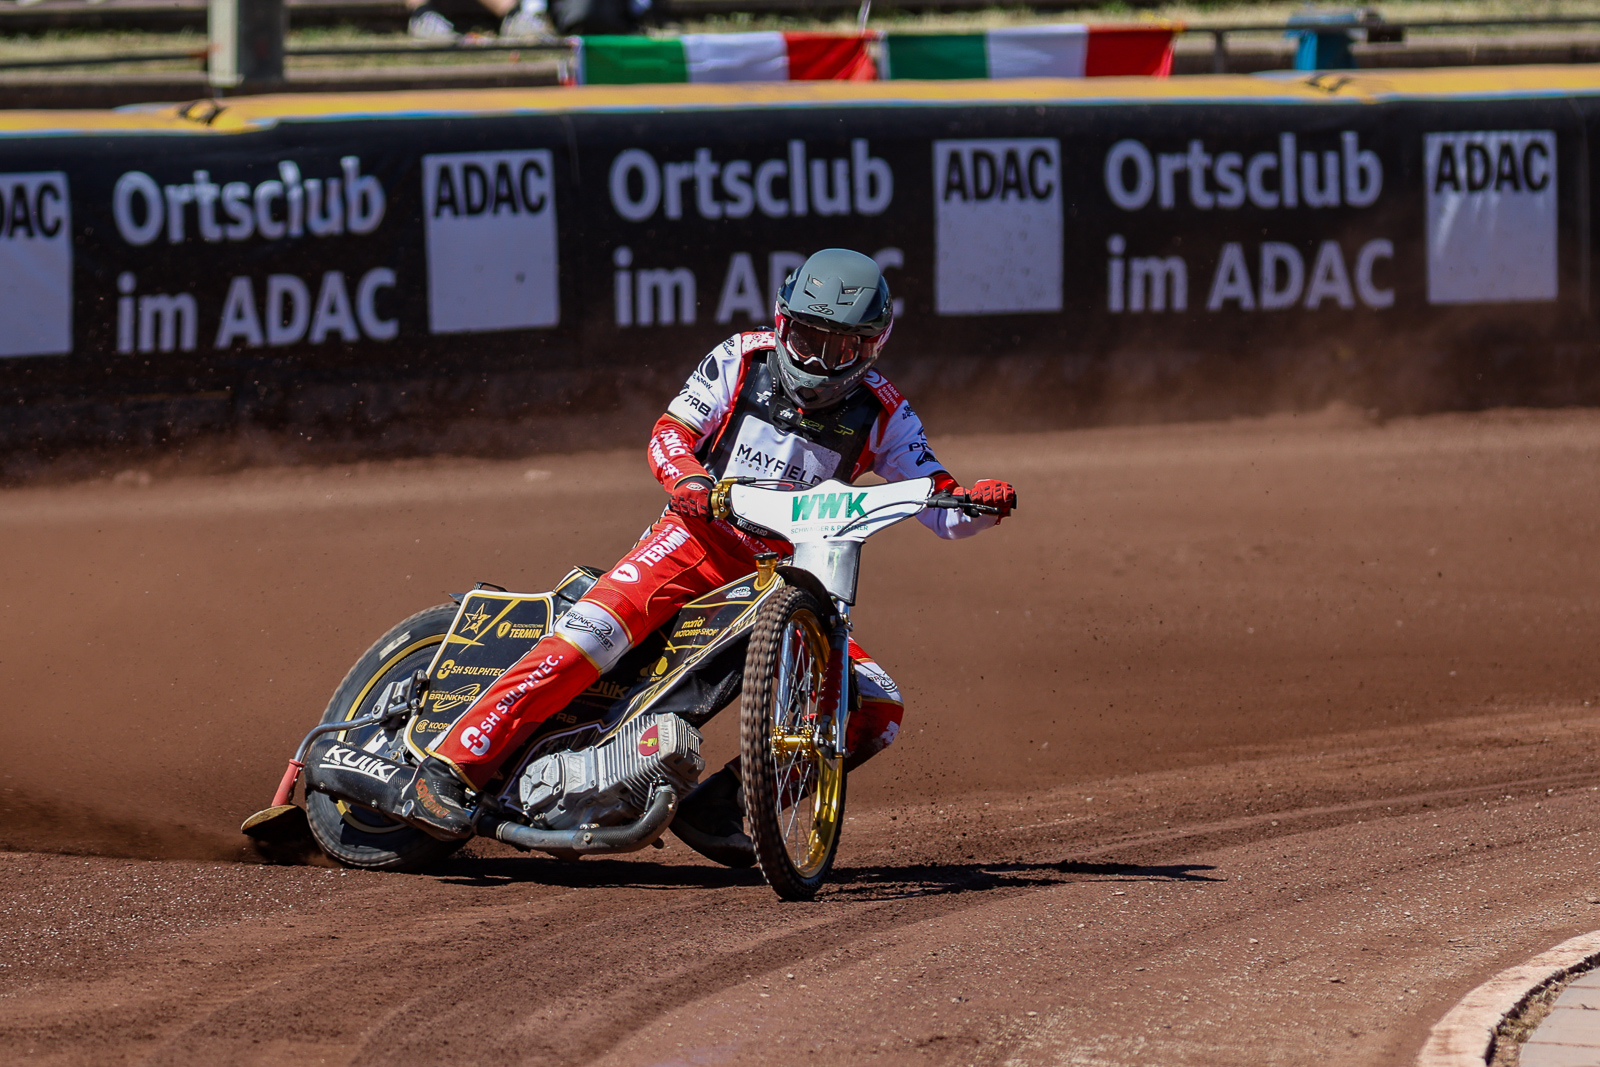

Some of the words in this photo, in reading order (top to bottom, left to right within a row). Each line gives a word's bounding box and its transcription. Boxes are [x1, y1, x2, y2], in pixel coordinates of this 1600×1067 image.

[608, 138, 894, 222] Ortsclub
[943, 147, 1054, 202] ADAC
[1104, 131, 1384, 211] Ortsclub
[1434, 140, 1551, 194] ADAC
[0, 181, 62, 239] AC
[112, 155, 386, 246] Ortsclub
[434, 159, 548, 219] ADAC
[613, 246, 697, 328] im
[715, 248, 905, 324] ADC
[1107, 234, 1188, 313] im
[1206, 239, 1396, 311] ADAC
[116, 271, 198, 354] im
[214, 266, 399, 349] ADAC
[877, 389, 890, 405] Sport
[886, 383, 900, 399] ADAC
[736, 443, 823, 486] MAYFIELD
[736, 518, 768, 537] WILDCARD
[791, 492, 868, 522] WWK
[636, 525, 691, 567] TERMIN
[508, 628, 543, 639] TERMIN
[565, 611, 616, 650] BRUNKHORST
[450, 666, 463, 676] SH
[464, 666, 505, 678] SULPHTEC
[428, 693, 477, 703] BRUNKHOR
[550, 712, 578, 724] RB
[427, 720, 451, 731] KOOP
[480, 712, 501, 734] SH
[415, 777, 450, 819] daytona
